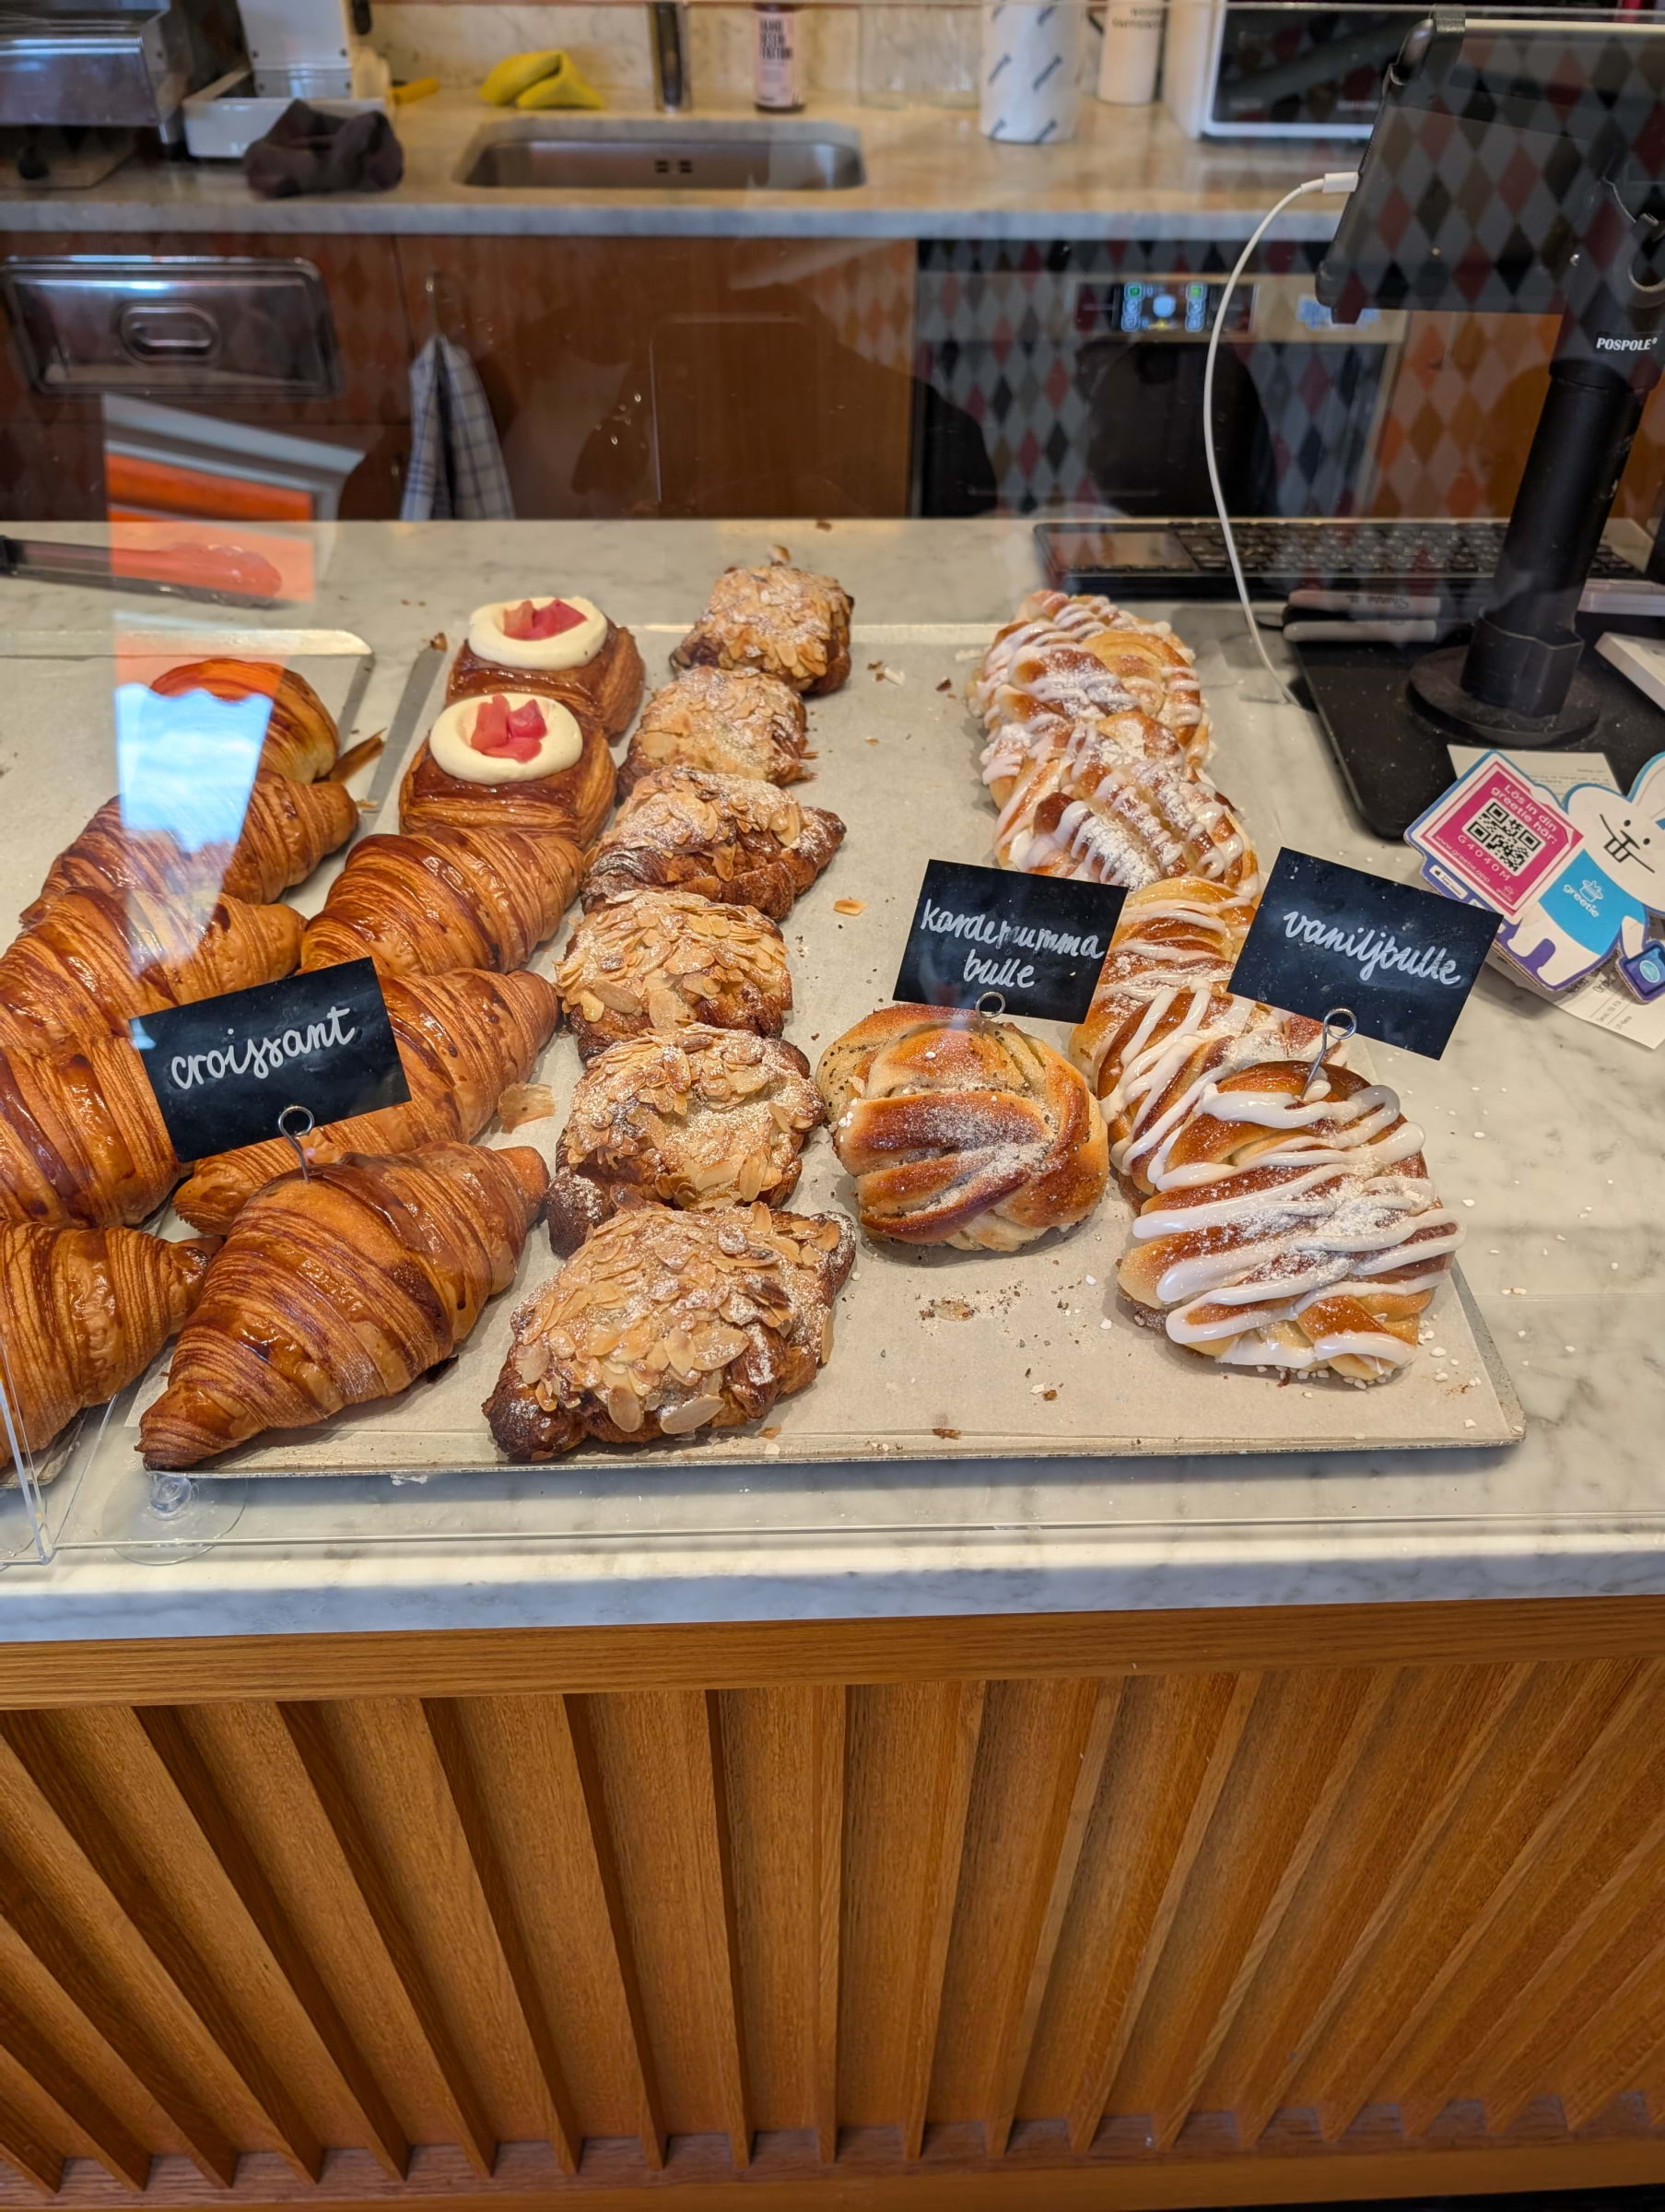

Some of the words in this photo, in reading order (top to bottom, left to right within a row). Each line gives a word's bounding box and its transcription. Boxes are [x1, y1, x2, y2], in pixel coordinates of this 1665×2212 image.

[1490, 786, 1532, 823] greetie
[1533, 821, 1559, 845] här:
[1504, 784, 1526, 805] Lös
[1525, 802, 1539, 816] in
[1538, 813, 1558, 832] din
[1435, 835, 1491, 884] www.greetie.app
[1563, 884, 1601, 919] greetie
[963, 949, 1036, 989] bulle
[1283, 911, 1461, 985] vaniljbulle
[171, 1006, 356, 1089] croissant
